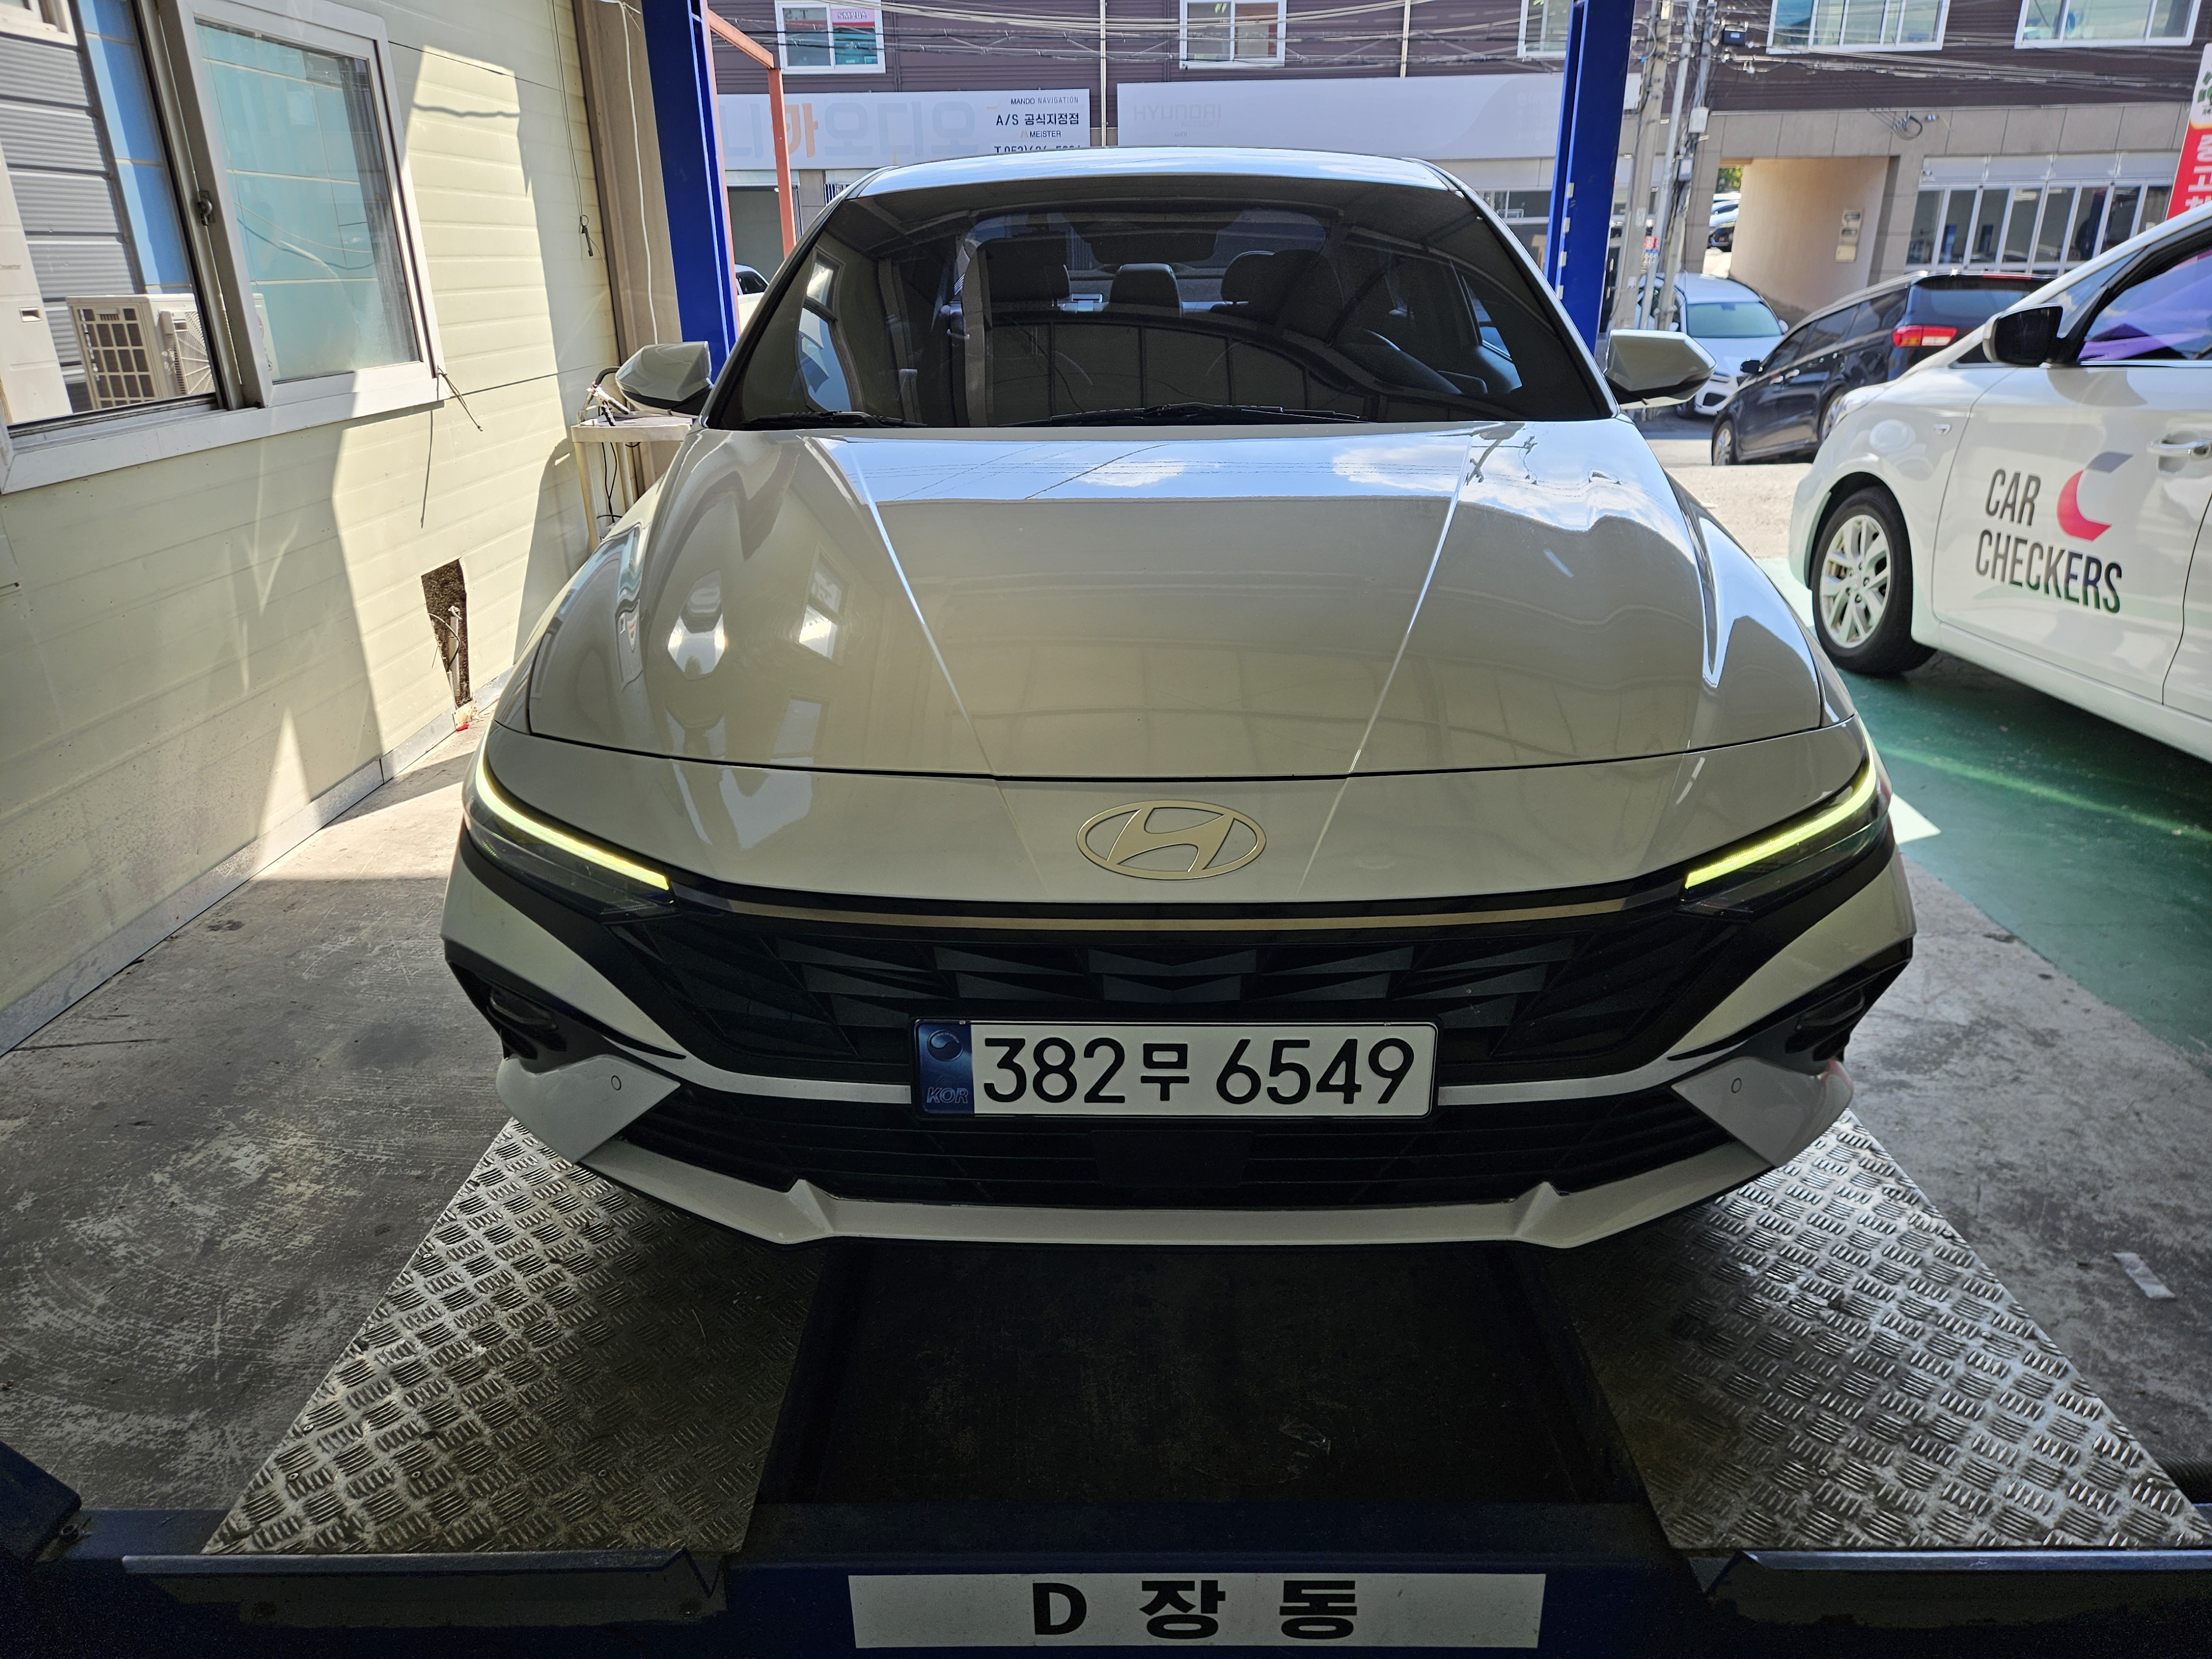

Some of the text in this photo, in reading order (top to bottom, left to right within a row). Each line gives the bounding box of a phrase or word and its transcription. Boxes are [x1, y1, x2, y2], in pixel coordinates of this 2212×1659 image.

[996, 113, 1079, 126] A/S 공식지정점
[1134, 103, 1222, 120] HYUNDAI
[1985, 468, 2042, 528] CAR
[1976, 529, 2122, 614] CHECKERS
[927, 1087, 968, 1104] KOR
[982, 1036, 1416, 1105] 382무 6549
[1032, 1582, 1087, 1636] D
